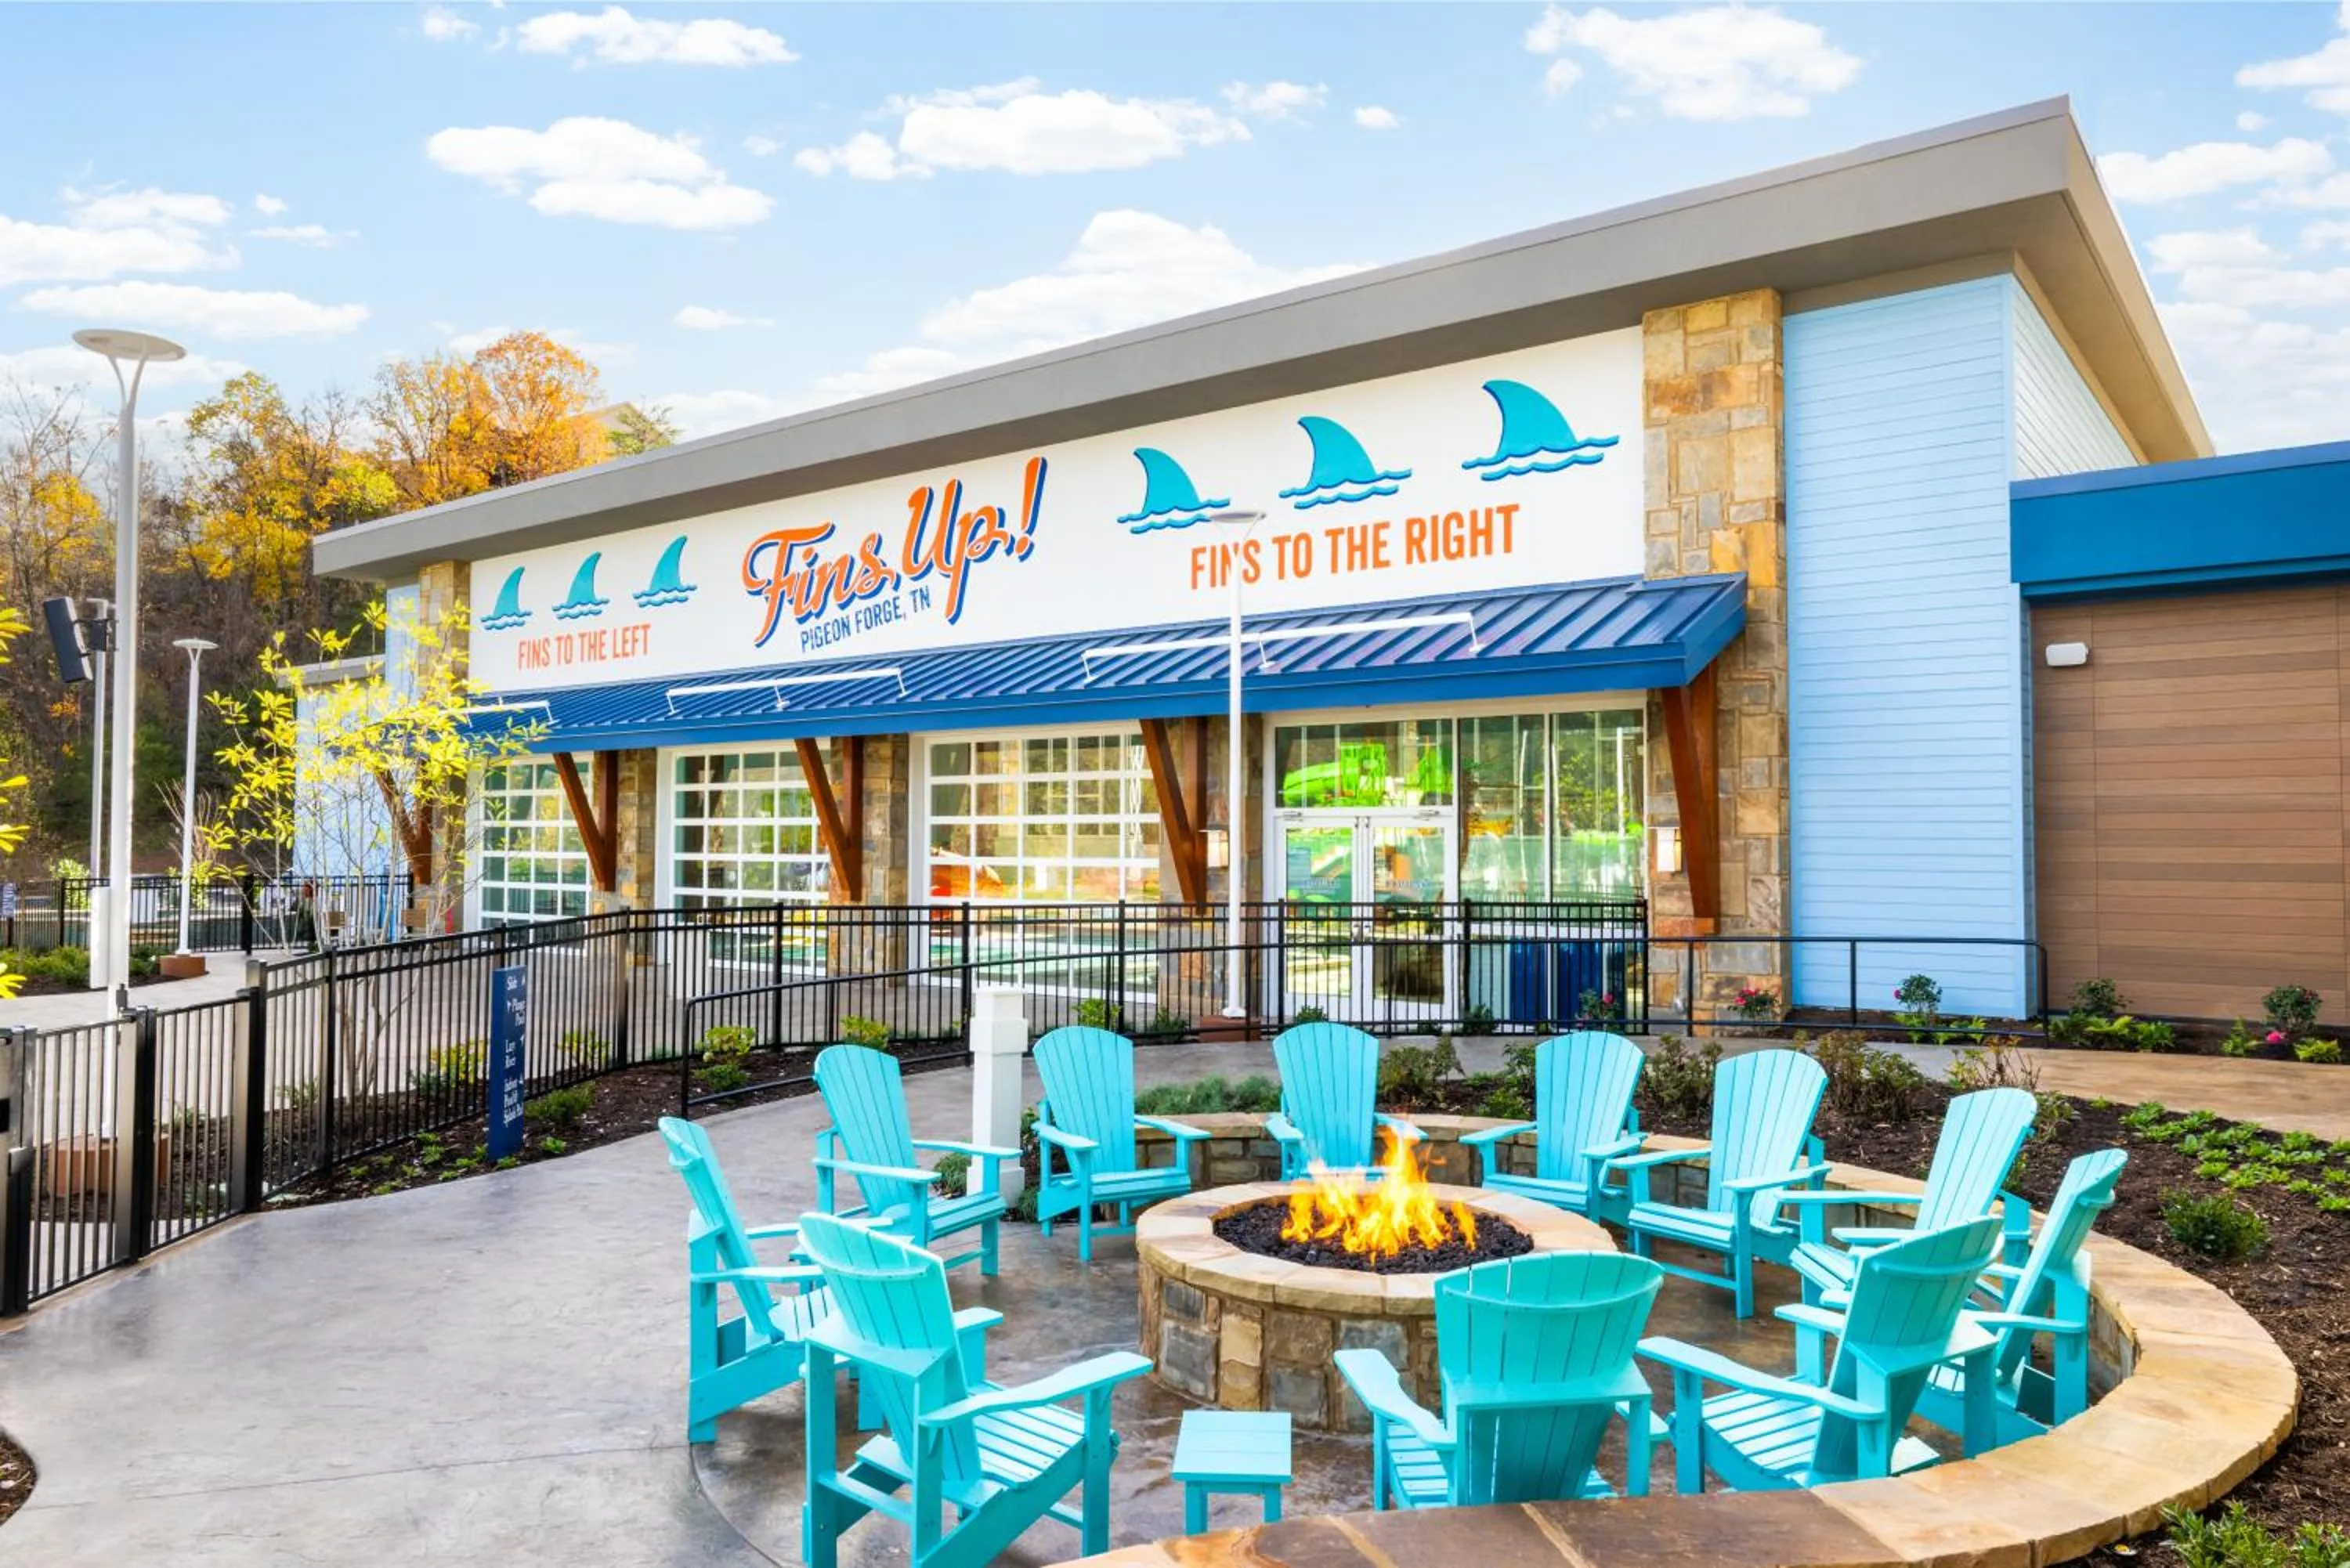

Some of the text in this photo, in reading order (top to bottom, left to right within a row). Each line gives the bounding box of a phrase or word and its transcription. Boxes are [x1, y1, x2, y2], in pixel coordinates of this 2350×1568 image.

[742, 456, 1047, 649] Fins Up!
[1191, 504, 1520, 590] FINS TO THE RIGHT
[518, 623, 652, 671] FINS TO THE LEFT
[801, 585, 931, 653] PIGEON FORGE, TN
